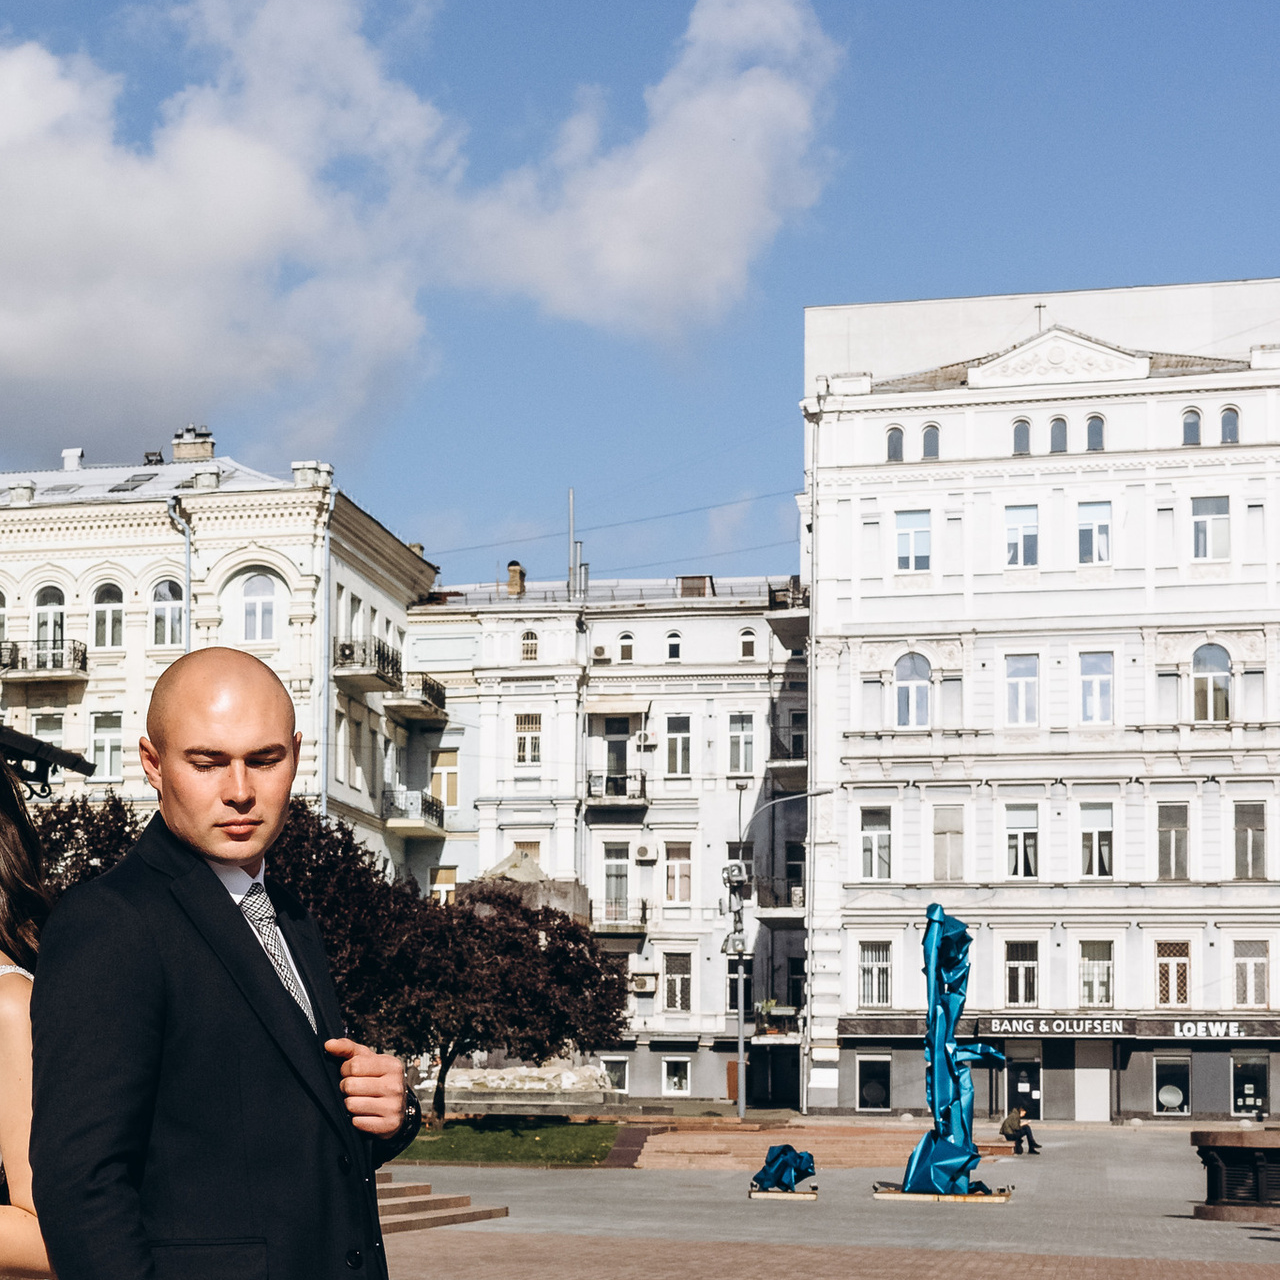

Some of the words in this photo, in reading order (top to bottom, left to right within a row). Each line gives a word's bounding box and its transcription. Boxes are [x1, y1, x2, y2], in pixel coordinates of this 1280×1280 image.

[991, 1019, 1034, 1033] BANG
[1038, 1019, 1050, 1033] &
[1052, 1019, 1124, 1033] OLUFSEN
[1174, 1022, 1245, 1037] LOEWE.
